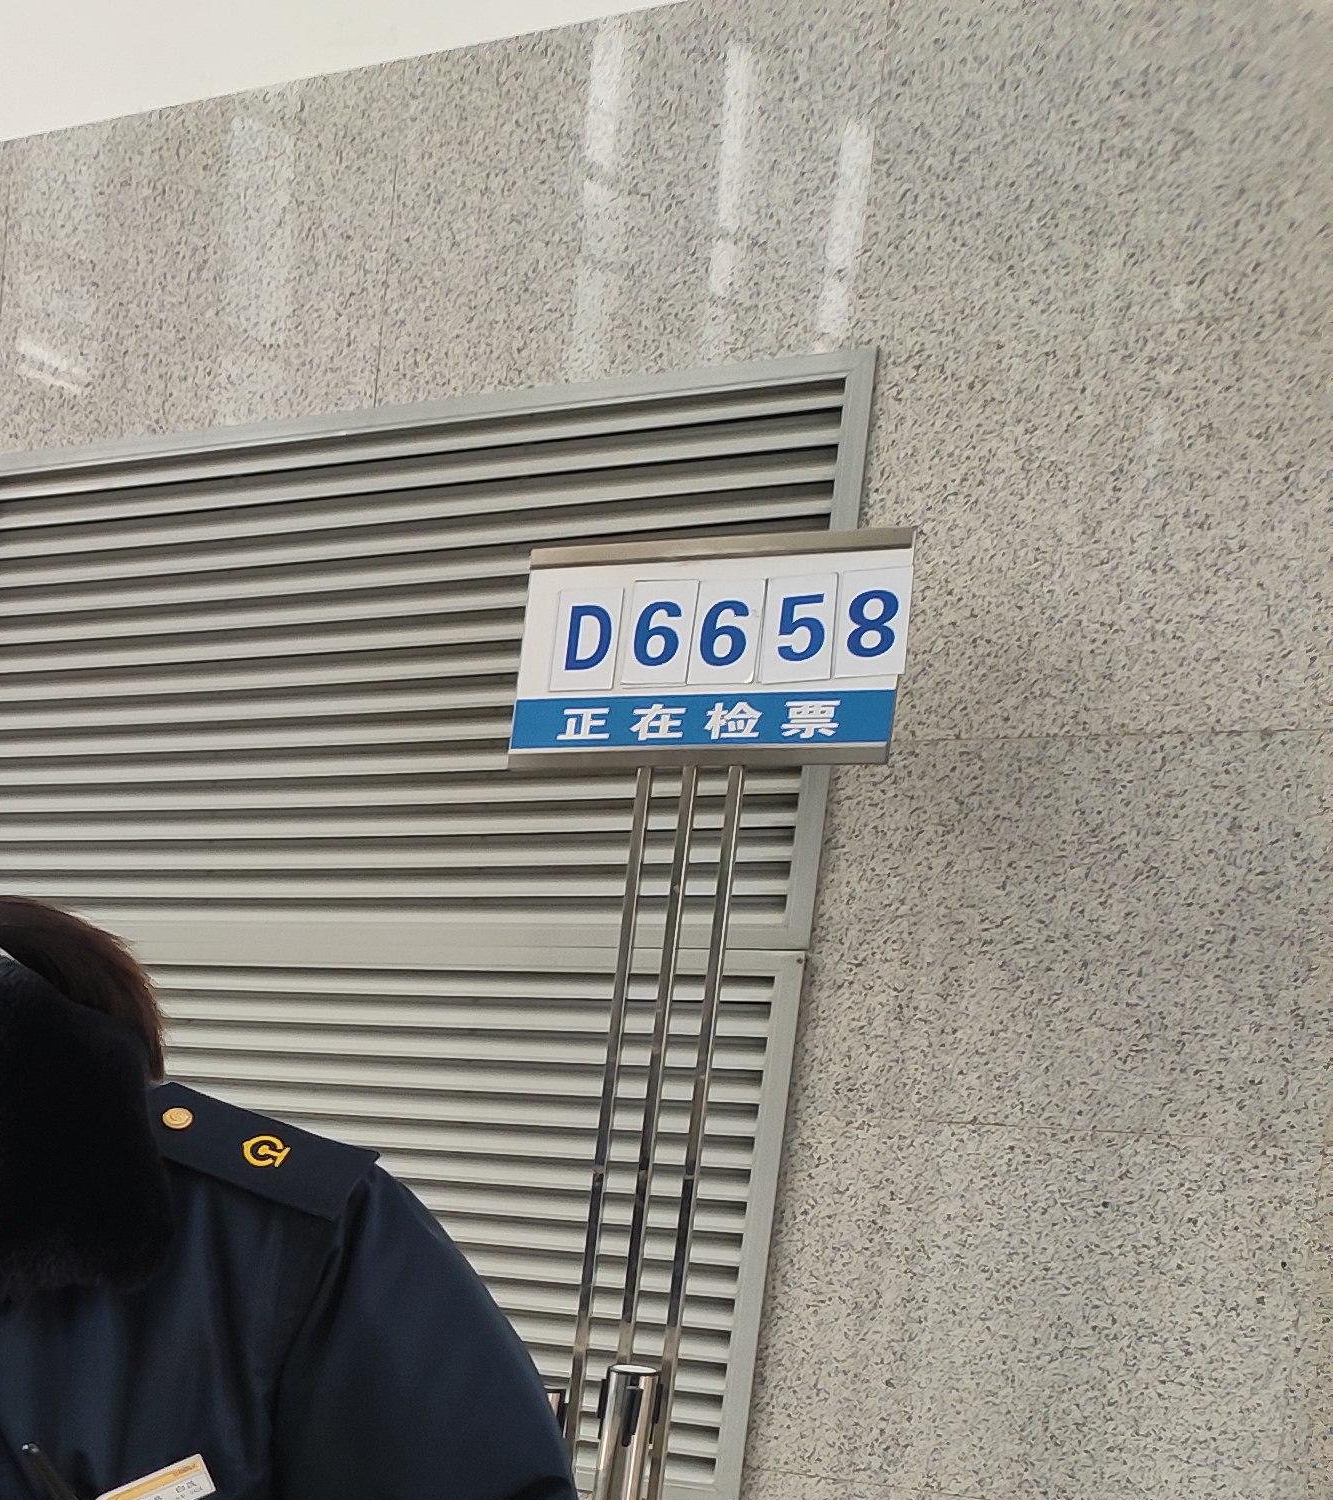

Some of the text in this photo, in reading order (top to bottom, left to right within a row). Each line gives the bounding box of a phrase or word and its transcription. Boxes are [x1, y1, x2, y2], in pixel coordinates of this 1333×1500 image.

[564, 589, 900, 671] D6658
[556, 700, 841, 741] 正在检票
